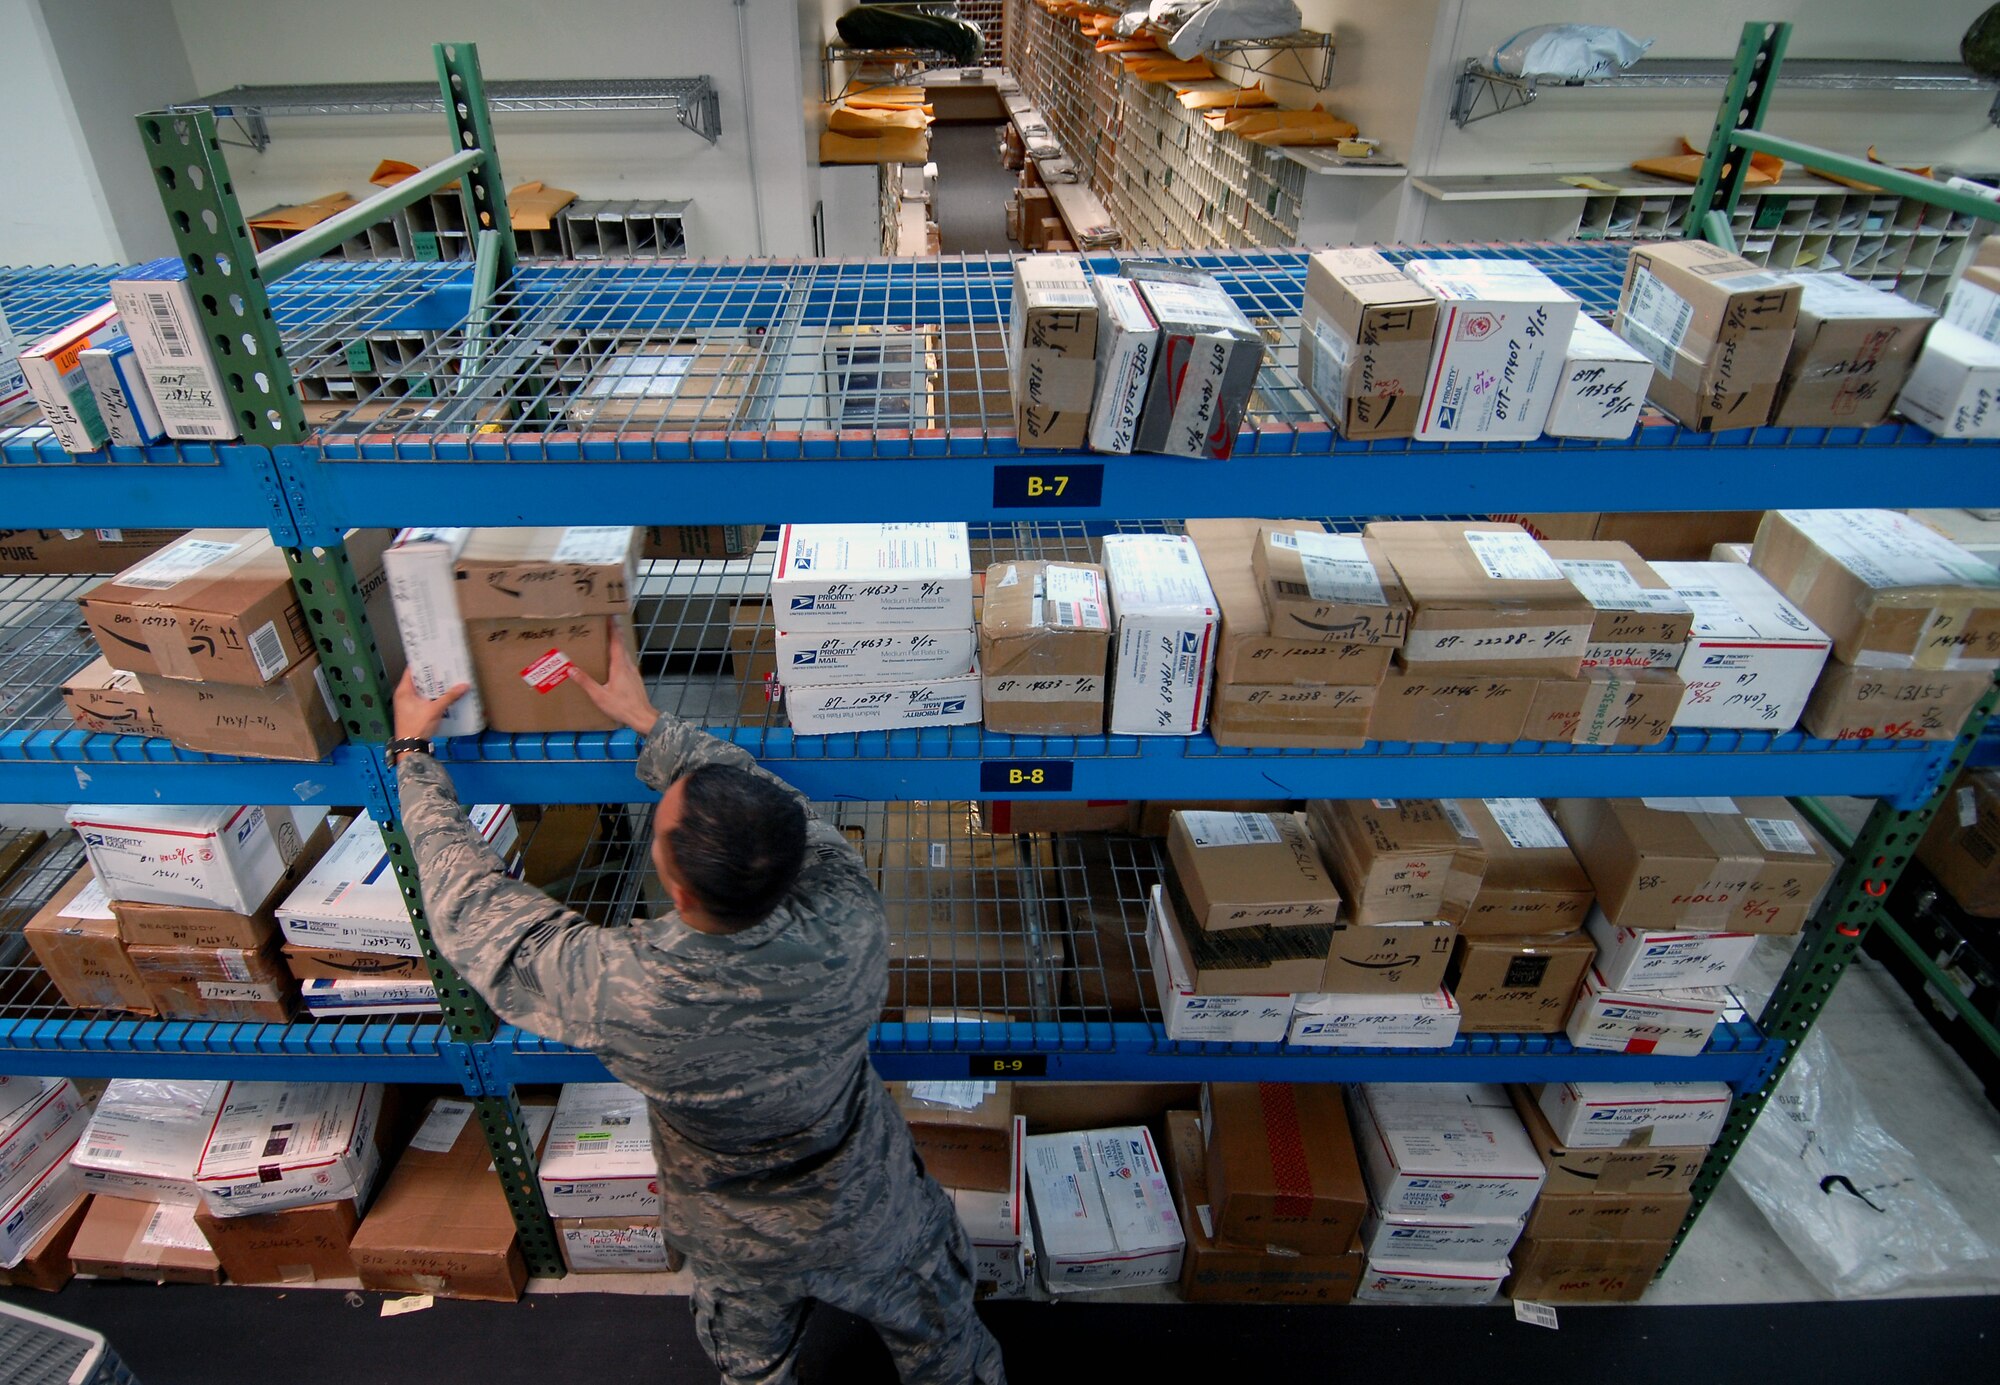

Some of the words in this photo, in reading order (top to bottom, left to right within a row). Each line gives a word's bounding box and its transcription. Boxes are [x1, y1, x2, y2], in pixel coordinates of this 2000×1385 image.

[1727, 305, 1748, 330] 8/15
[1503, 340, 1521, 383] 17407
[1442, 369, 1456, 404] PRIORITY
[1577, 380, 1628, 398] 17356
[1452, 386, 1463, 406] MAIL
[1028, 476, 1069, 496] B-7
[1, 546, 38, 561] PURE
[817, 593, 855, 601] PRIORITY
[920, 581, 944, 598] 8/15
[911, 634, 937, 650] 8/15
[1543, 629, 1573, 648] 8/15
[1649, 648, 1672, 661] 7/29
[1178, 654, 1187, 672] MAIL
[1187, 655, 1197, 688] PRIORITY
[1738, 673, 1758, 686] B7
[1685, 681, 1721, 690] HOLD
[1894, 684, 1954, 700] 13155
[909, 687, 935, 706] 8/15
[1334, 690, 1362, 708] 8/15
[1688, 688, 1713, 705] 8/22
[1009, 769, 1044, 785] B-8
[104, 834, 142, 846] PRIORITY
[104, 841, 127, 850] MAIL
[308, 920, 338, 928] PRIORITY
[1628, 1009, 1662, 1017] PRIORITY
[993, 1060, 1023, 1072] B-9
[225, 1105, 234, 1113] P
[1105, 1145, 1113, 1161] YOU
[1109, 1139, 1120, 1167] SUPPORTS
[1114, 1138, 1125, 1166] AMERICA
